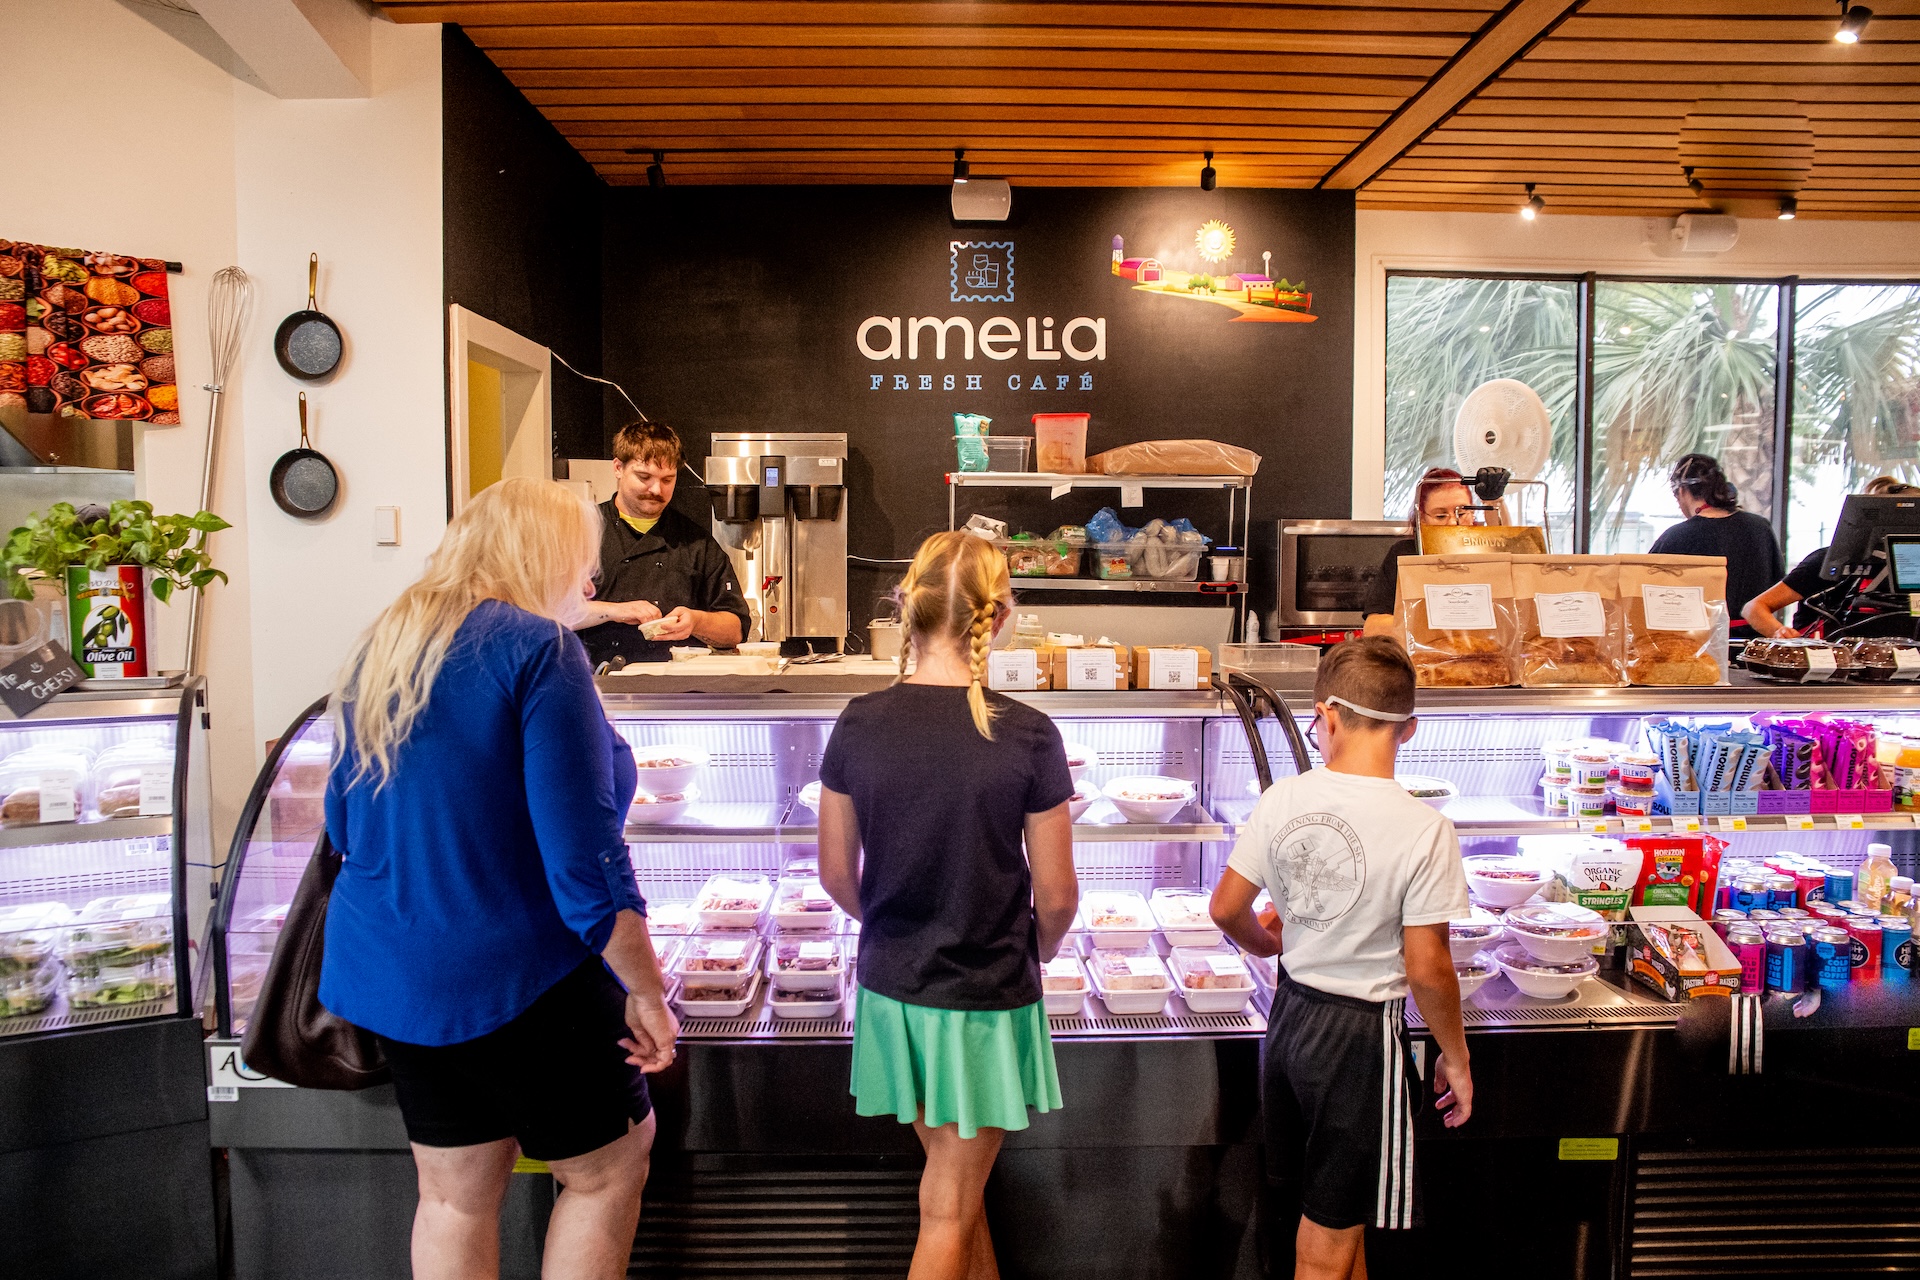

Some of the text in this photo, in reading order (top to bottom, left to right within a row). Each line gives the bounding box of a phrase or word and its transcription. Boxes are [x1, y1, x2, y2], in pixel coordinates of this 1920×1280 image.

[870, 372, 1093, 391] FRESH CAFÉ
[86, 651, 133, 662] Olive Oil
[0, 673, 18, 690] TIP
[16, 679, 36, 691] THE
[1710, 747, 1728, 791] RUMROLL
[1736, 749, 1759, 791] RUMROLL
[1784, 742, 1794, 790] RUMROLL
[1275, 815, 1364, 865] LIGHTNING FROM THE SKY
[1654, 848, 1685, 857] HORIZON
[1584, 867, 1622, 876] ORGANIC
[1588, 874, 1620, 882] VALLEY
[1819, 971, 1848, 979] COFFE
[1683, 979, 1705, 990] PASTURE
[1719, 977, 1739, 988] RAISED
